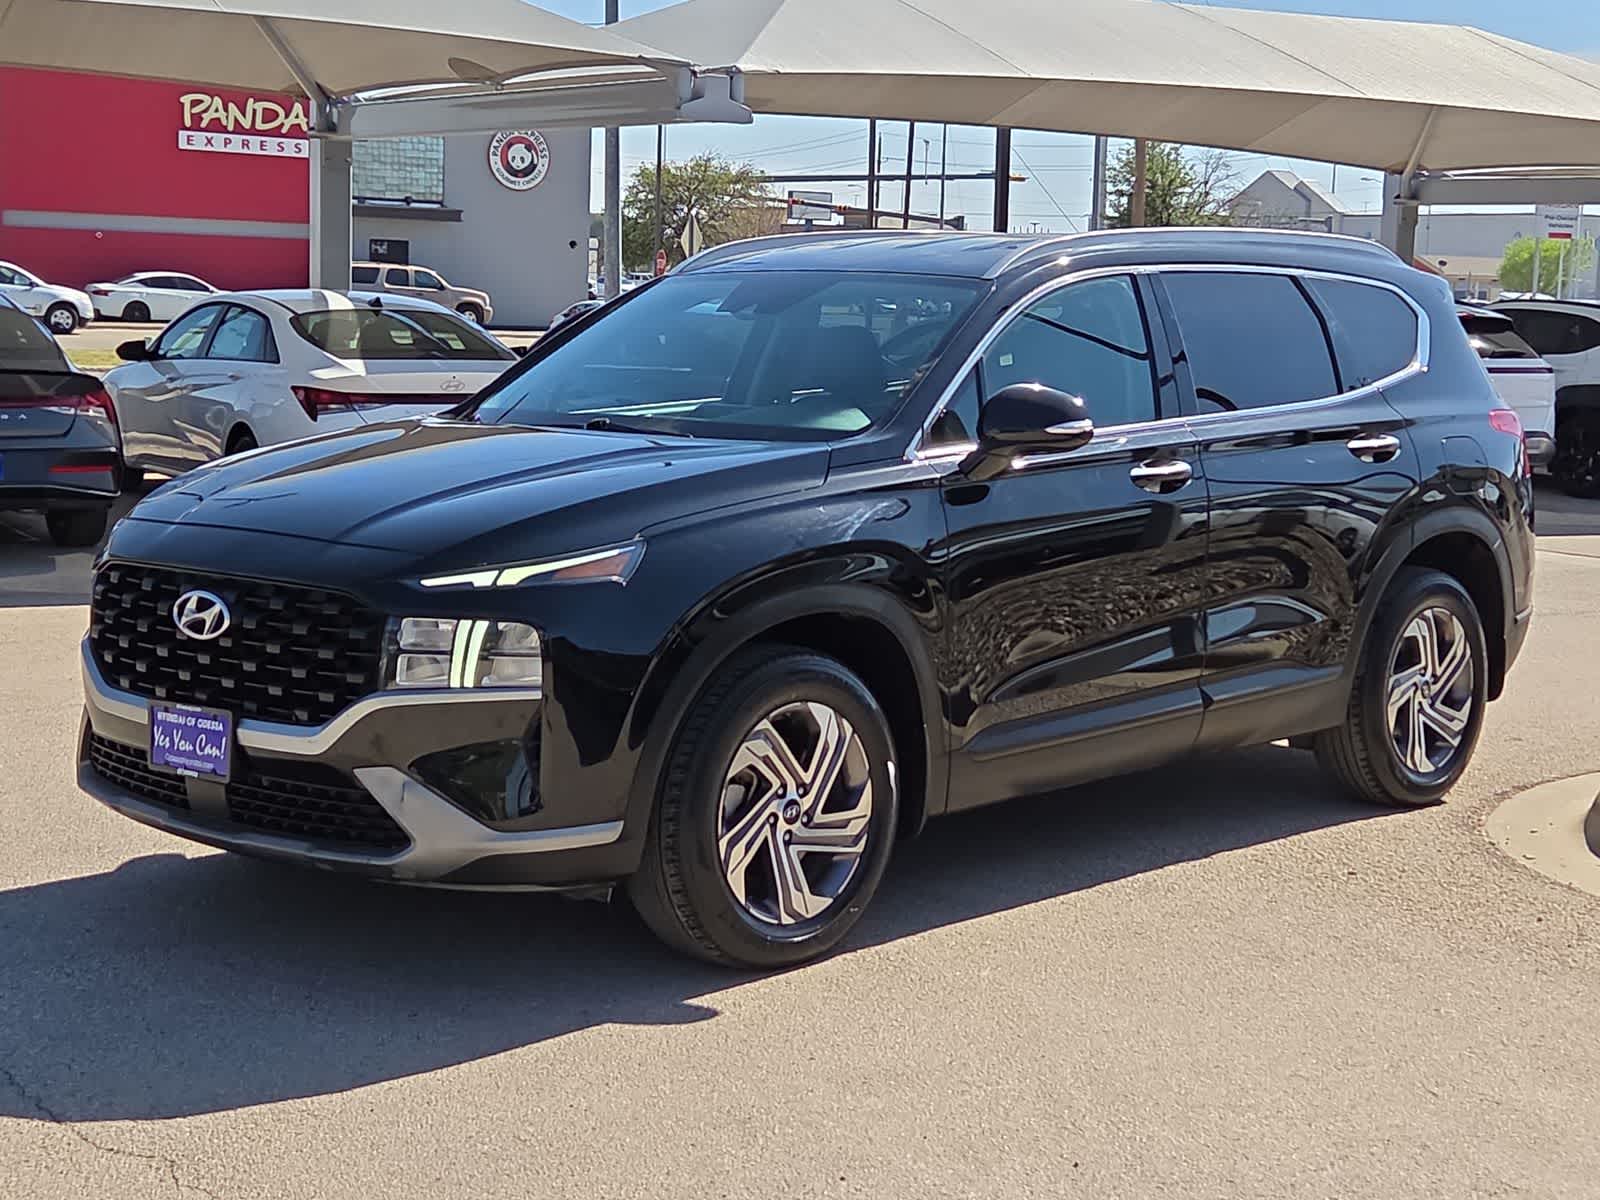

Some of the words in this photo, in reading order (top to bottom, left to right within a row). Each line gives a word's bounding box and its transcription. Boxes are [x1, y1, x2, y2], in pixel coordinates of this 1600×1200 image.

[179, 93, 308, 134] PANDA
[186, 134, 303, 154] EXPRESS
[186, 716, 196, 727] OF
[197, 718, 224, 732] ODESSA
[153, 725, 170, 750] Yes
[173, 728, 194, 752] You
[195, 733, 227, 760] Can!
